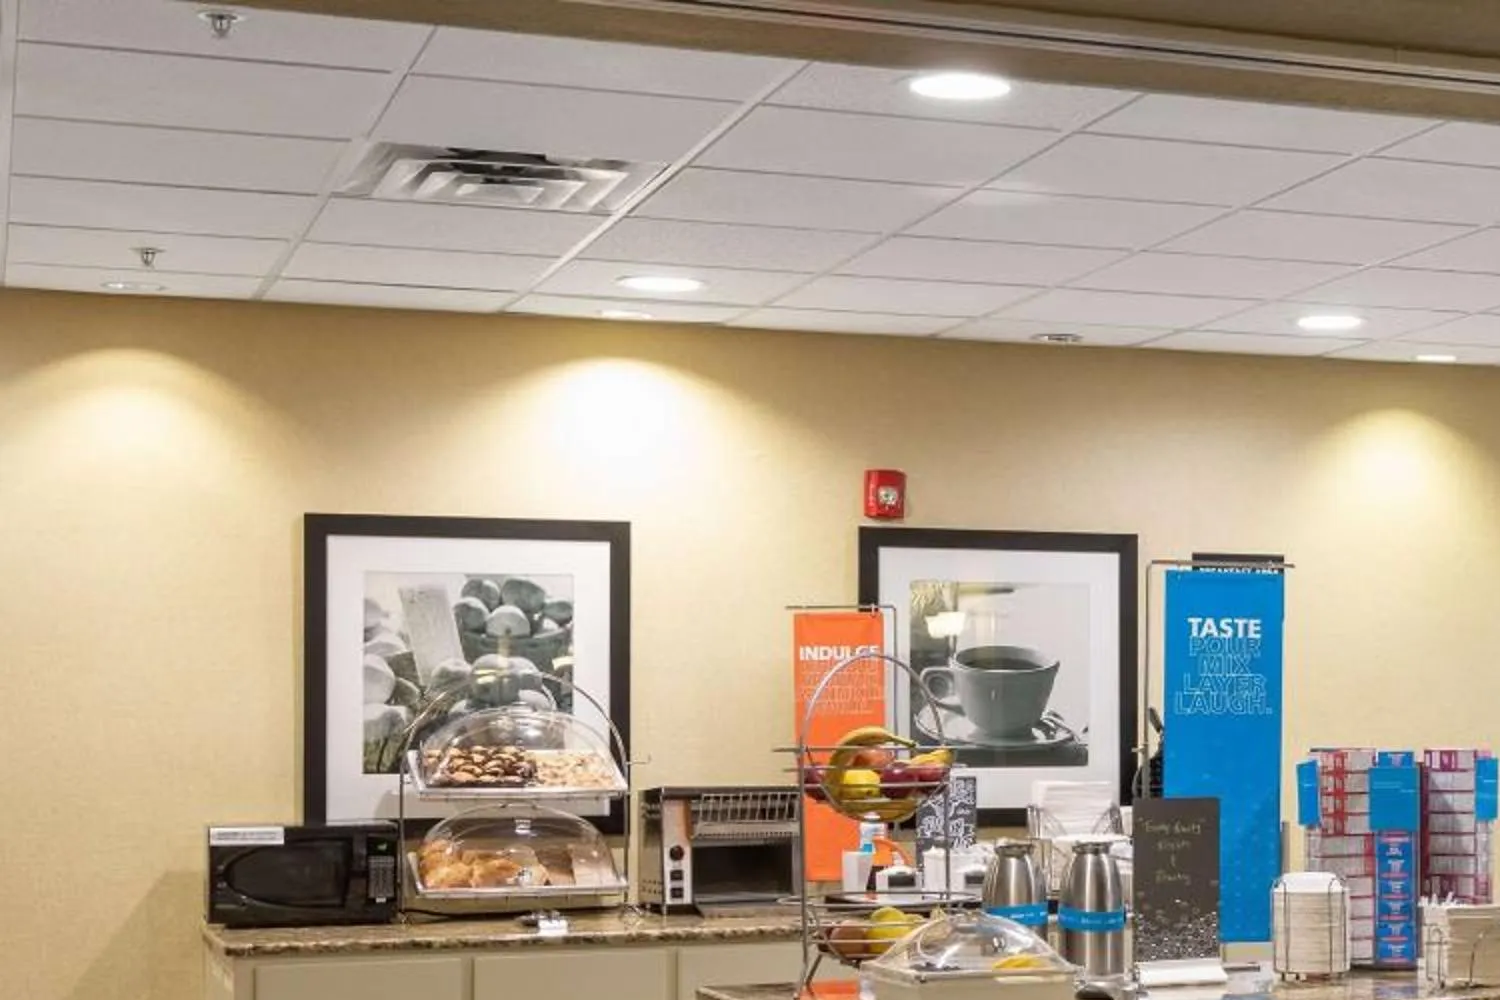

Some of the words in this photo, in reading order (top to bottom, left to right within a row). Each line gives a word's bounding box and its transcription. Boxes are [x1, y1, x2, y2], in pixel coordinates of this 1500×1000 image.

[1187, 617, 1261, 638] TASTE
[1189, 637, 1261, 657] POUR
[1200, 653, 1252, 675] MIX
[1183, 673, 1267, 696] LAYER
[1176, 691, 1273, 715] LAUGH.
